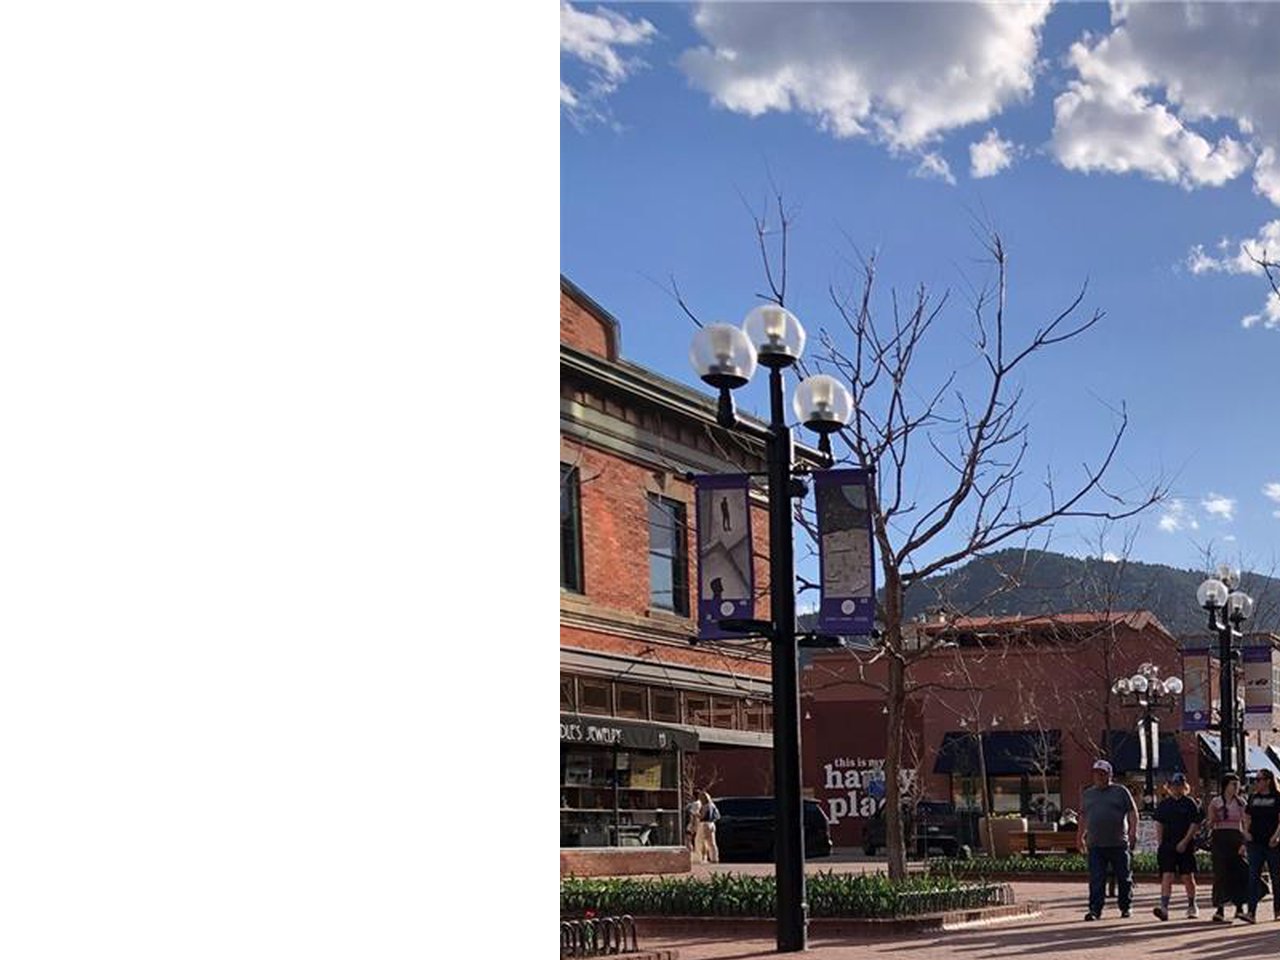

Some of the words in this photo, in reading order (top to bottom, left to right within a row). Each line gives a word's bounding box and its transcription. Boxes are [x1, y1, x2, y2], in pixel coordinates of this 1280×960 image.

[834, 757, 856, 768] this
[857, 757, 867, 768] is
[869, 758, 886, 771] my
